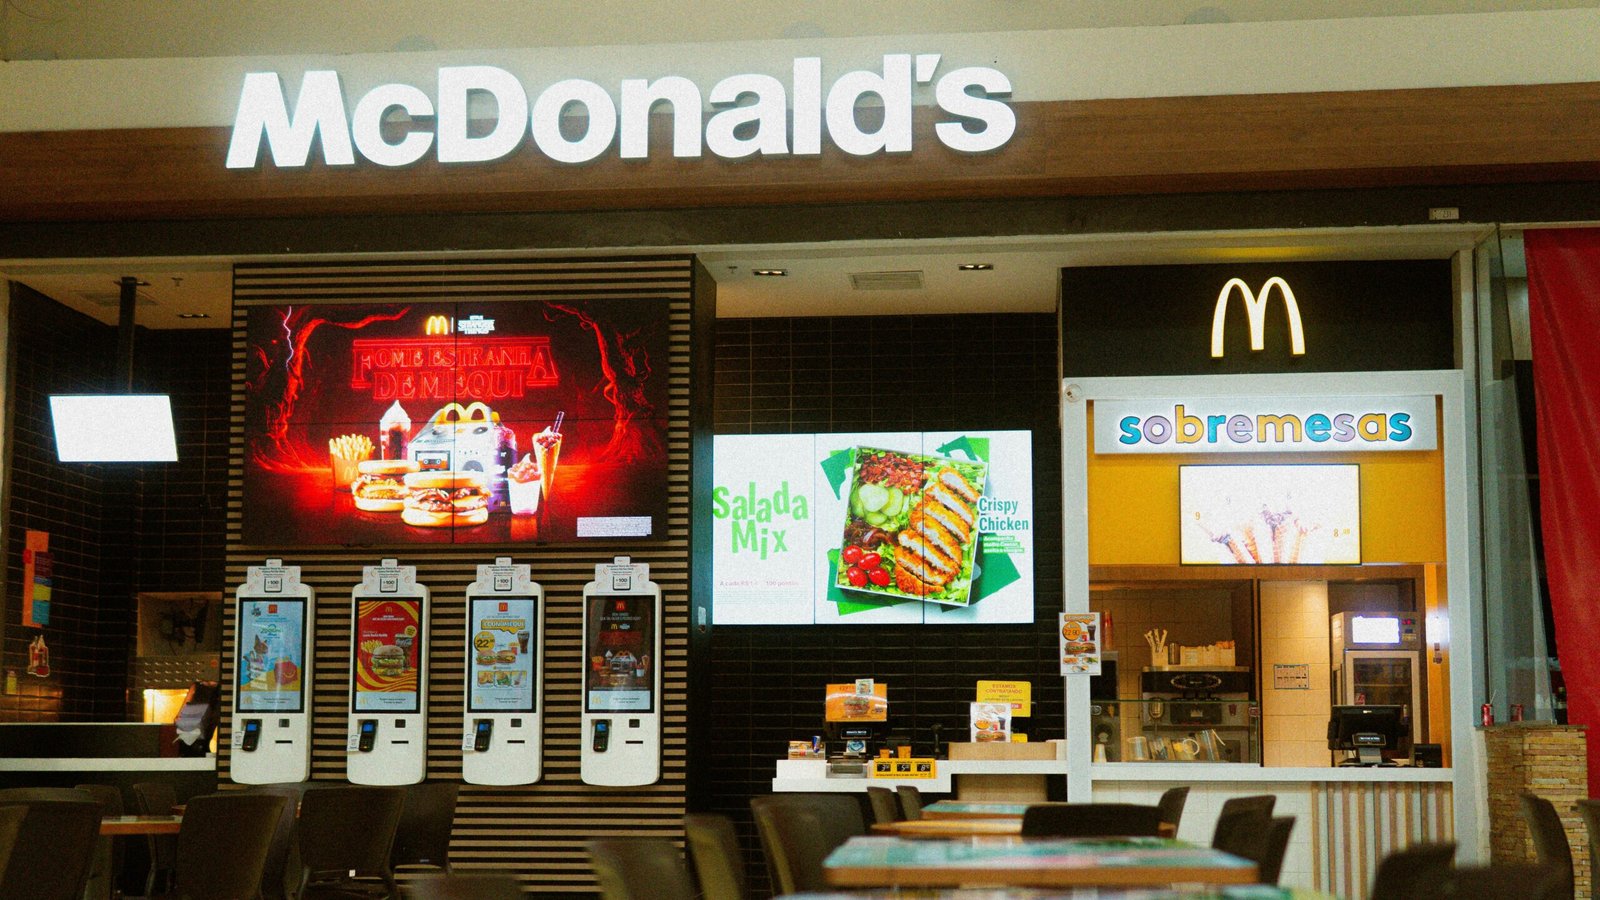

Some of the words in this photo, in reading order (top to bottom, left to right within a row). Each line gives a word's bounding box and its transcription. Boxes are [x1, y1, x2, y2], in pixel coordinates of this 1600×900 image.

[226, 54, 1016, 169] McDonald's
[352, 348, 424, 387] FOME
[428, 346, 558, 386] ESTRANHA
[373, 372, 415, 399] DE
[1119, 404, 1412, 444] sobremesas
[713, 480, 808, 523] Salada
[979, 497, 1018, 515] Crispy
[731, 520, 788, 560] Mix
[979, 517, 1029, 531] Chicken
